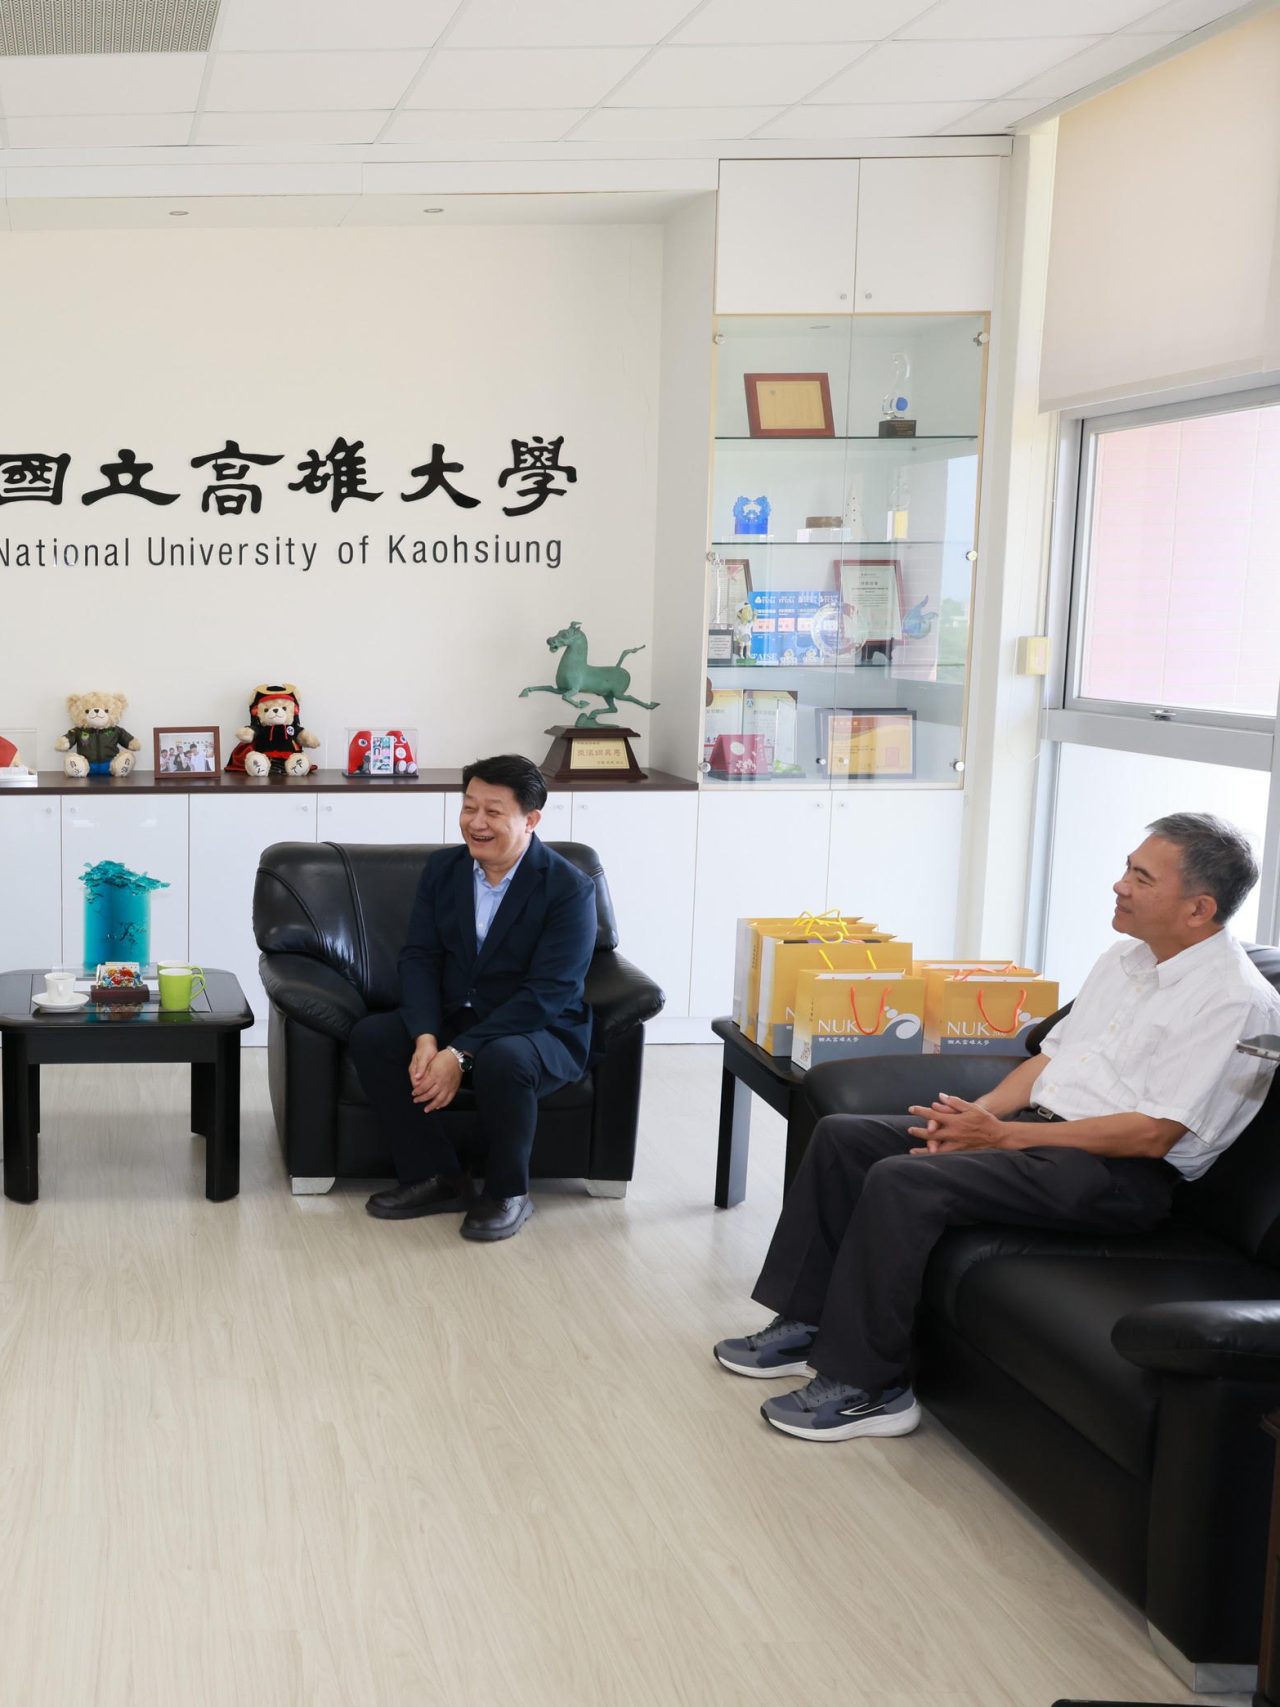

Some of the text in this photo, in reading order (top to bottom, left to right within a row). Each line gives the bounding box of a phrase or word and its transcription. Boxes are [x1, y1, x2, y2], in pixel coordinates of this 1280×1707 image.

[147, 536, 318, 572] University
[337, 535, 370, 565] of
[388, 534, 562, 569] Kaohsiung
[818, 1019, 859, 1034] NUK
[947, 1021, 991, 1036] NUK
